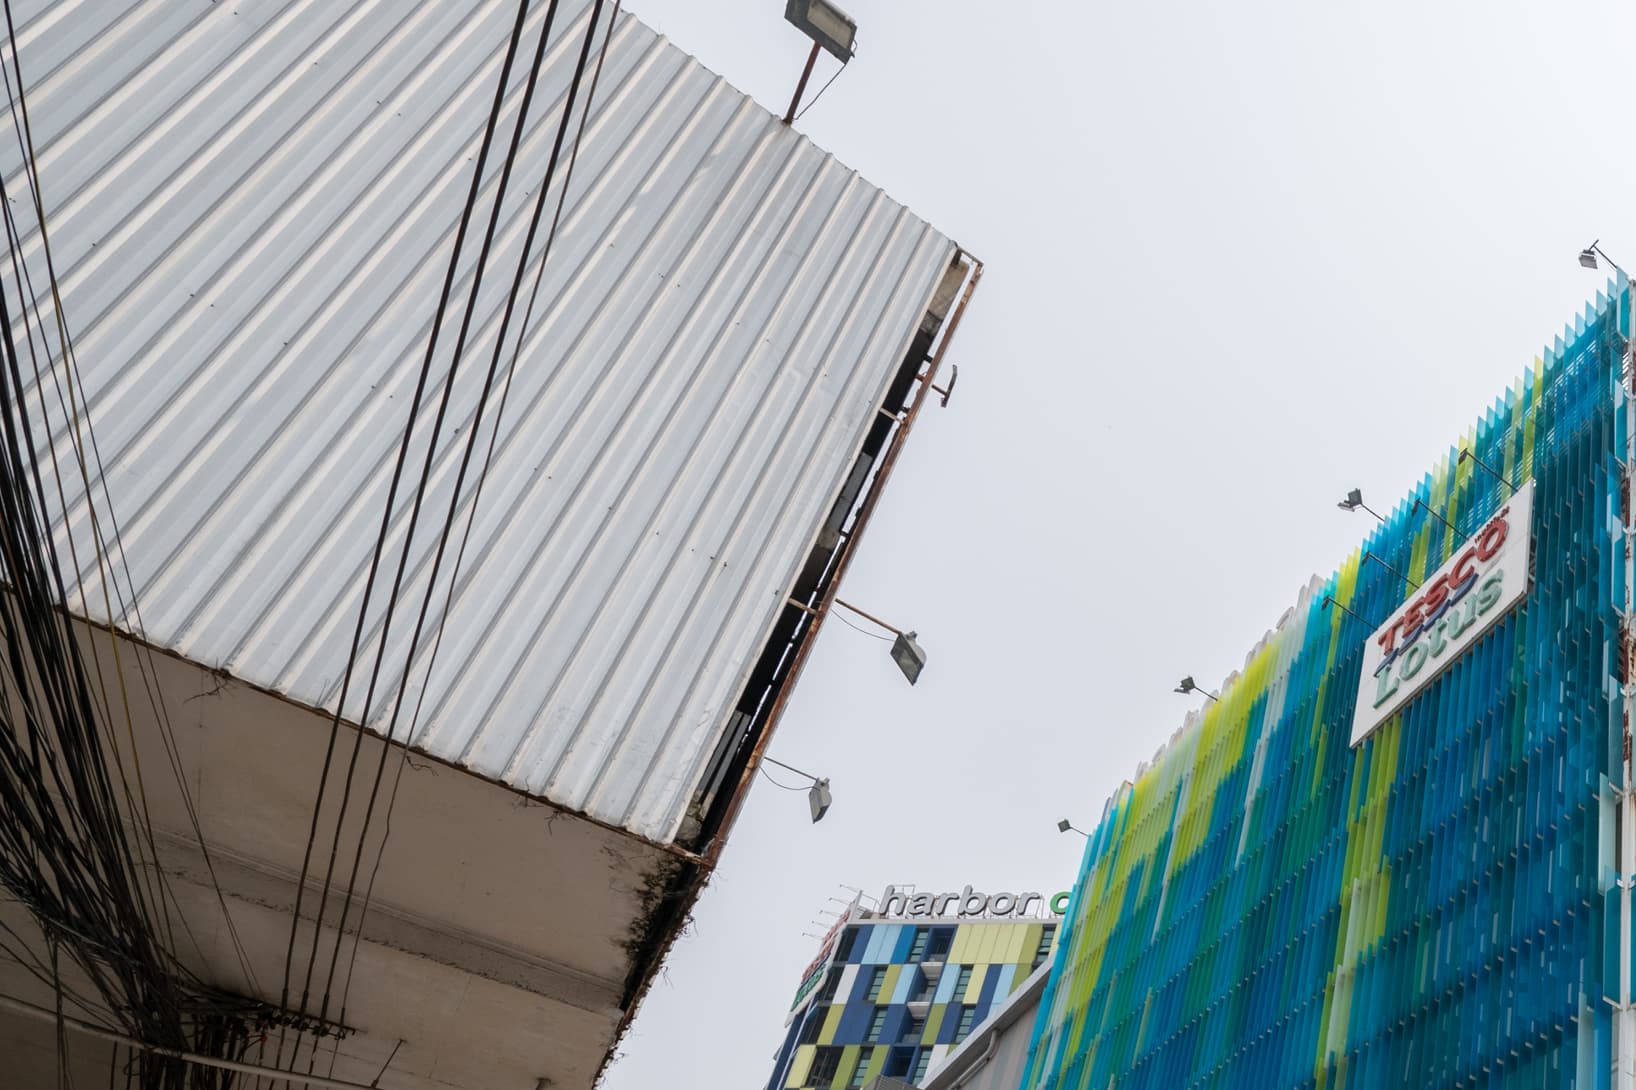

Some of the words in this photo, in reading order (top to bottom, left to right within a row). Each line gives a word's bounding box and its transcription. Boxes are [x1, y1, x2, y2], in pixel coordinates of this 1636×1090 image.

[1373, 569, 1504, 709] Lotus
[1378, 518, 1510, 657] TESCO
[879, 885, 1041, 916] harbor
